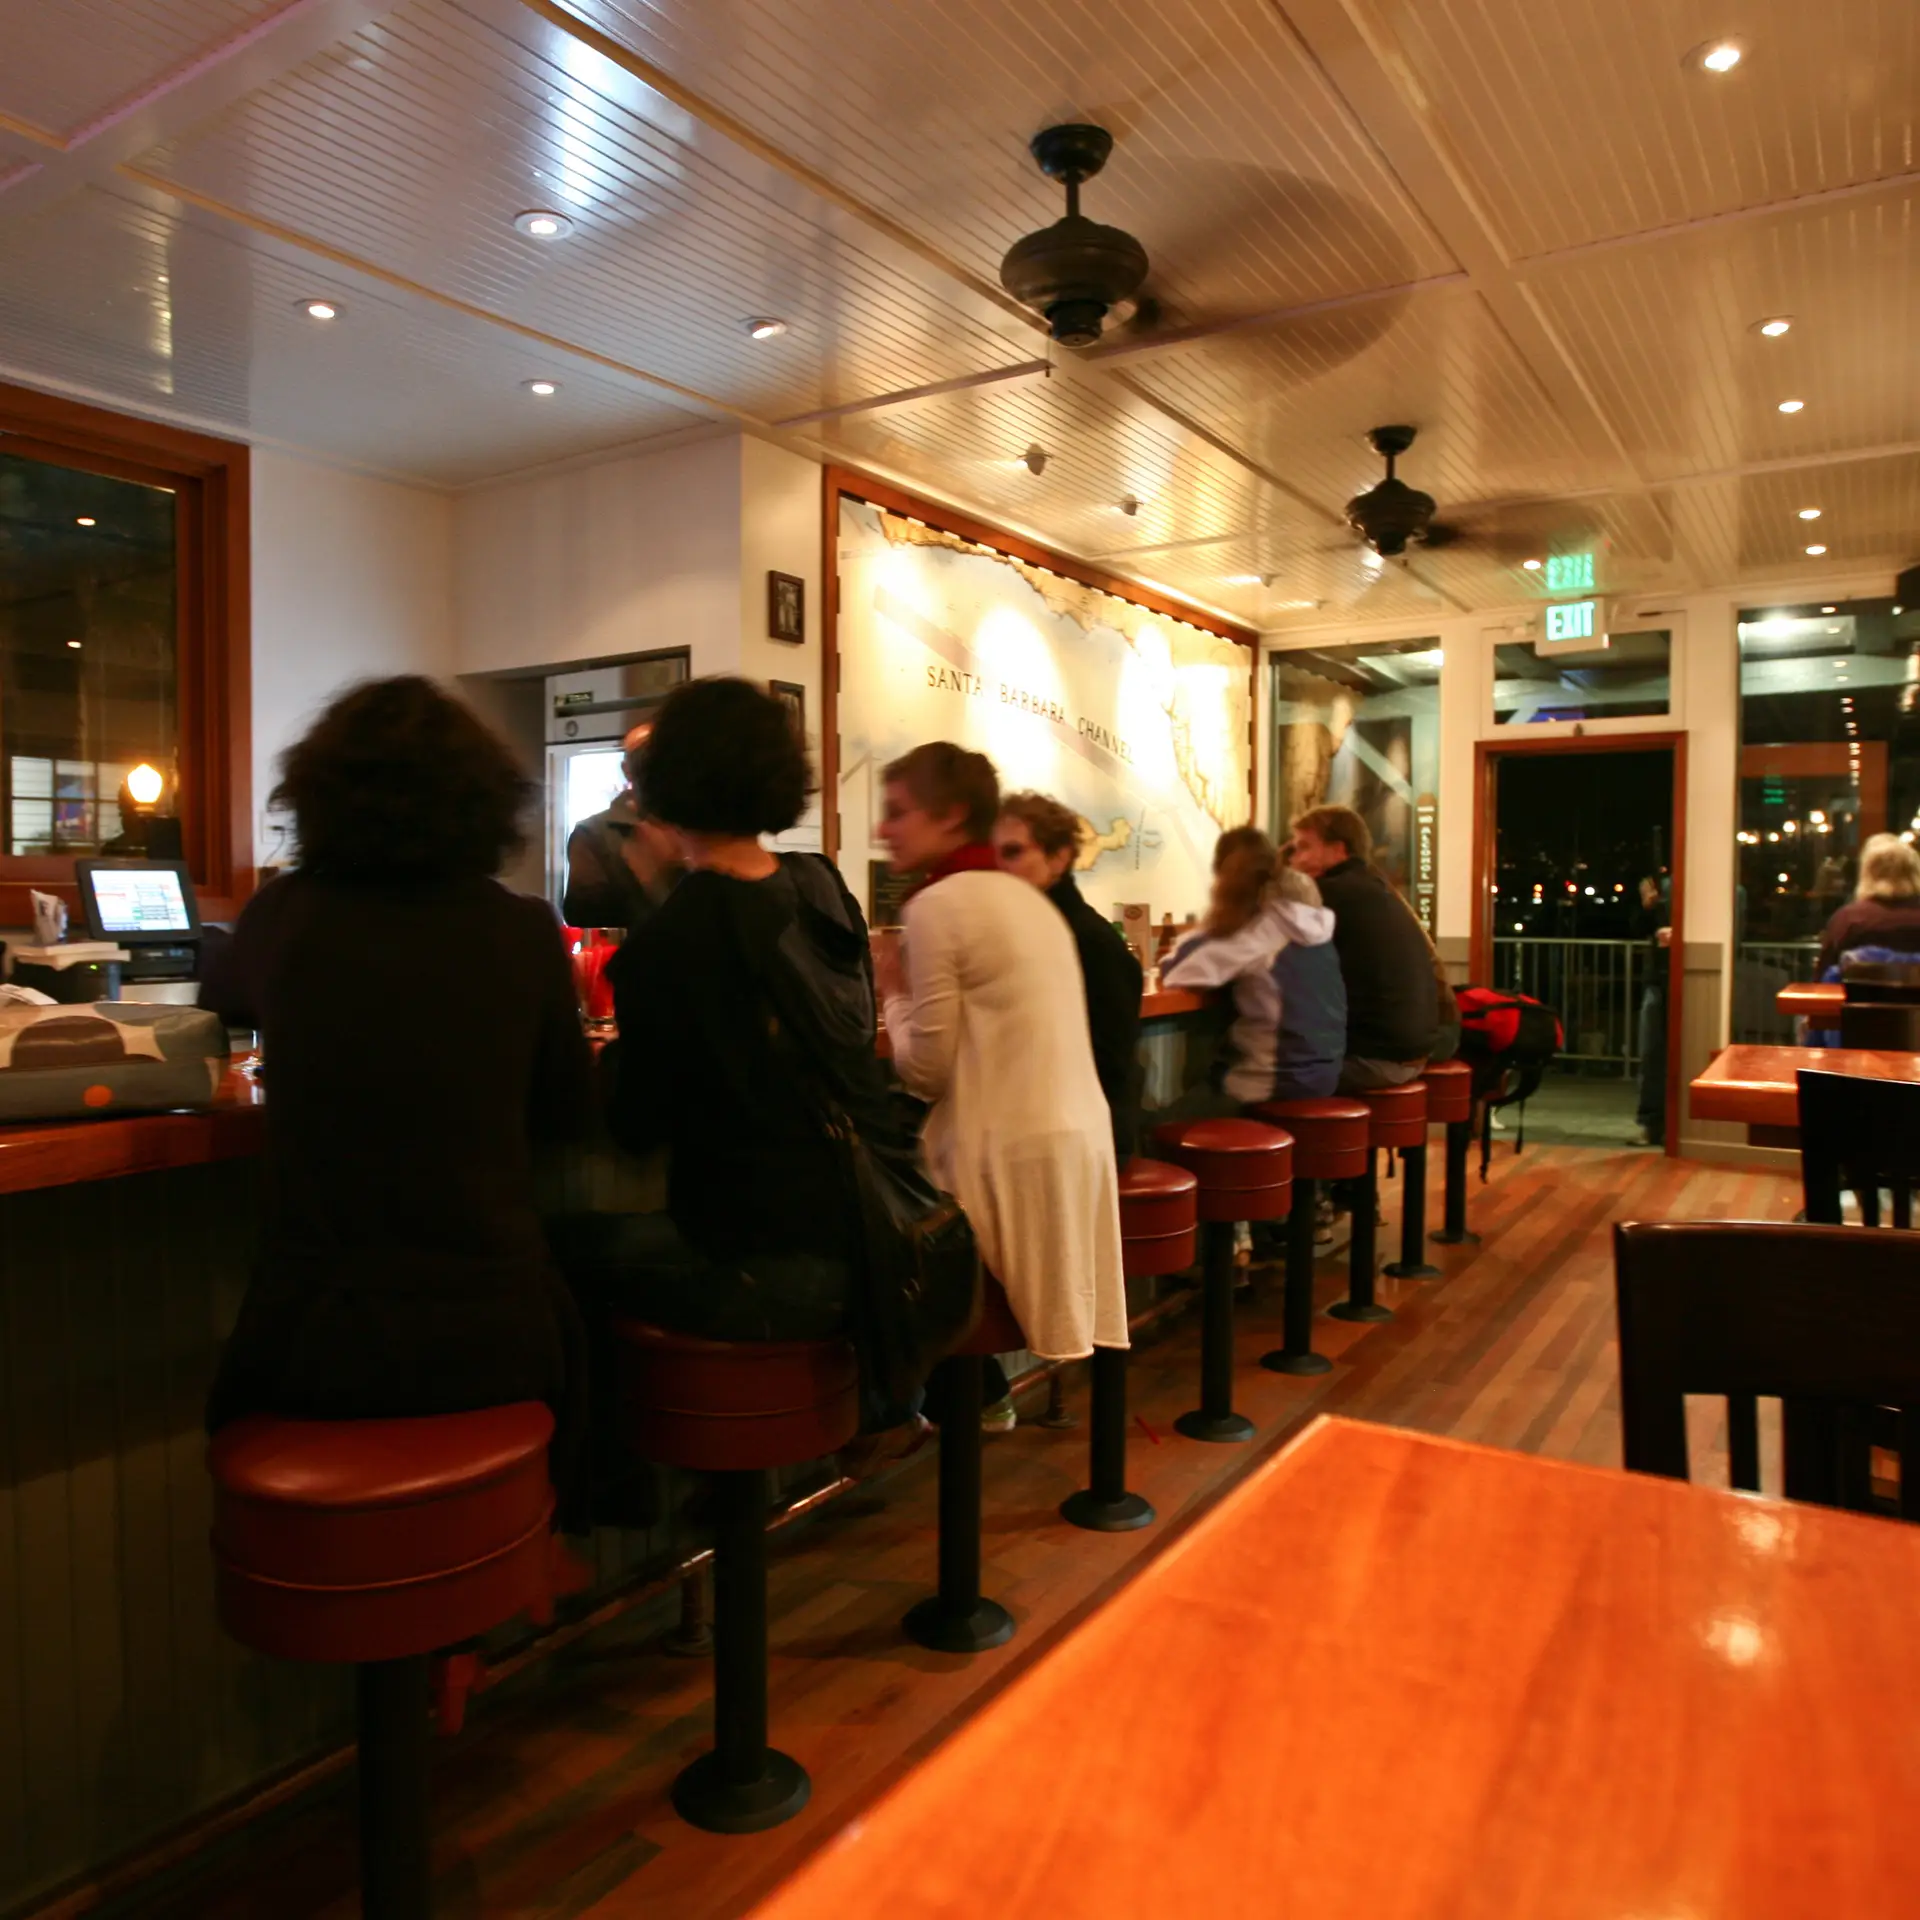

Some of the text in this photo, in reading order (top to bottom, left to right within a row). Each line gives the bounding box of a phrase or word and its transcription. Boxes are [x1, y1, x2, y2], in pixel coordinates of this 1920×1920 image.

[1546, 601, 1594, 641] EXIT
[927, 665, 1134, 764] SANTA BARBARA CHANNEL
